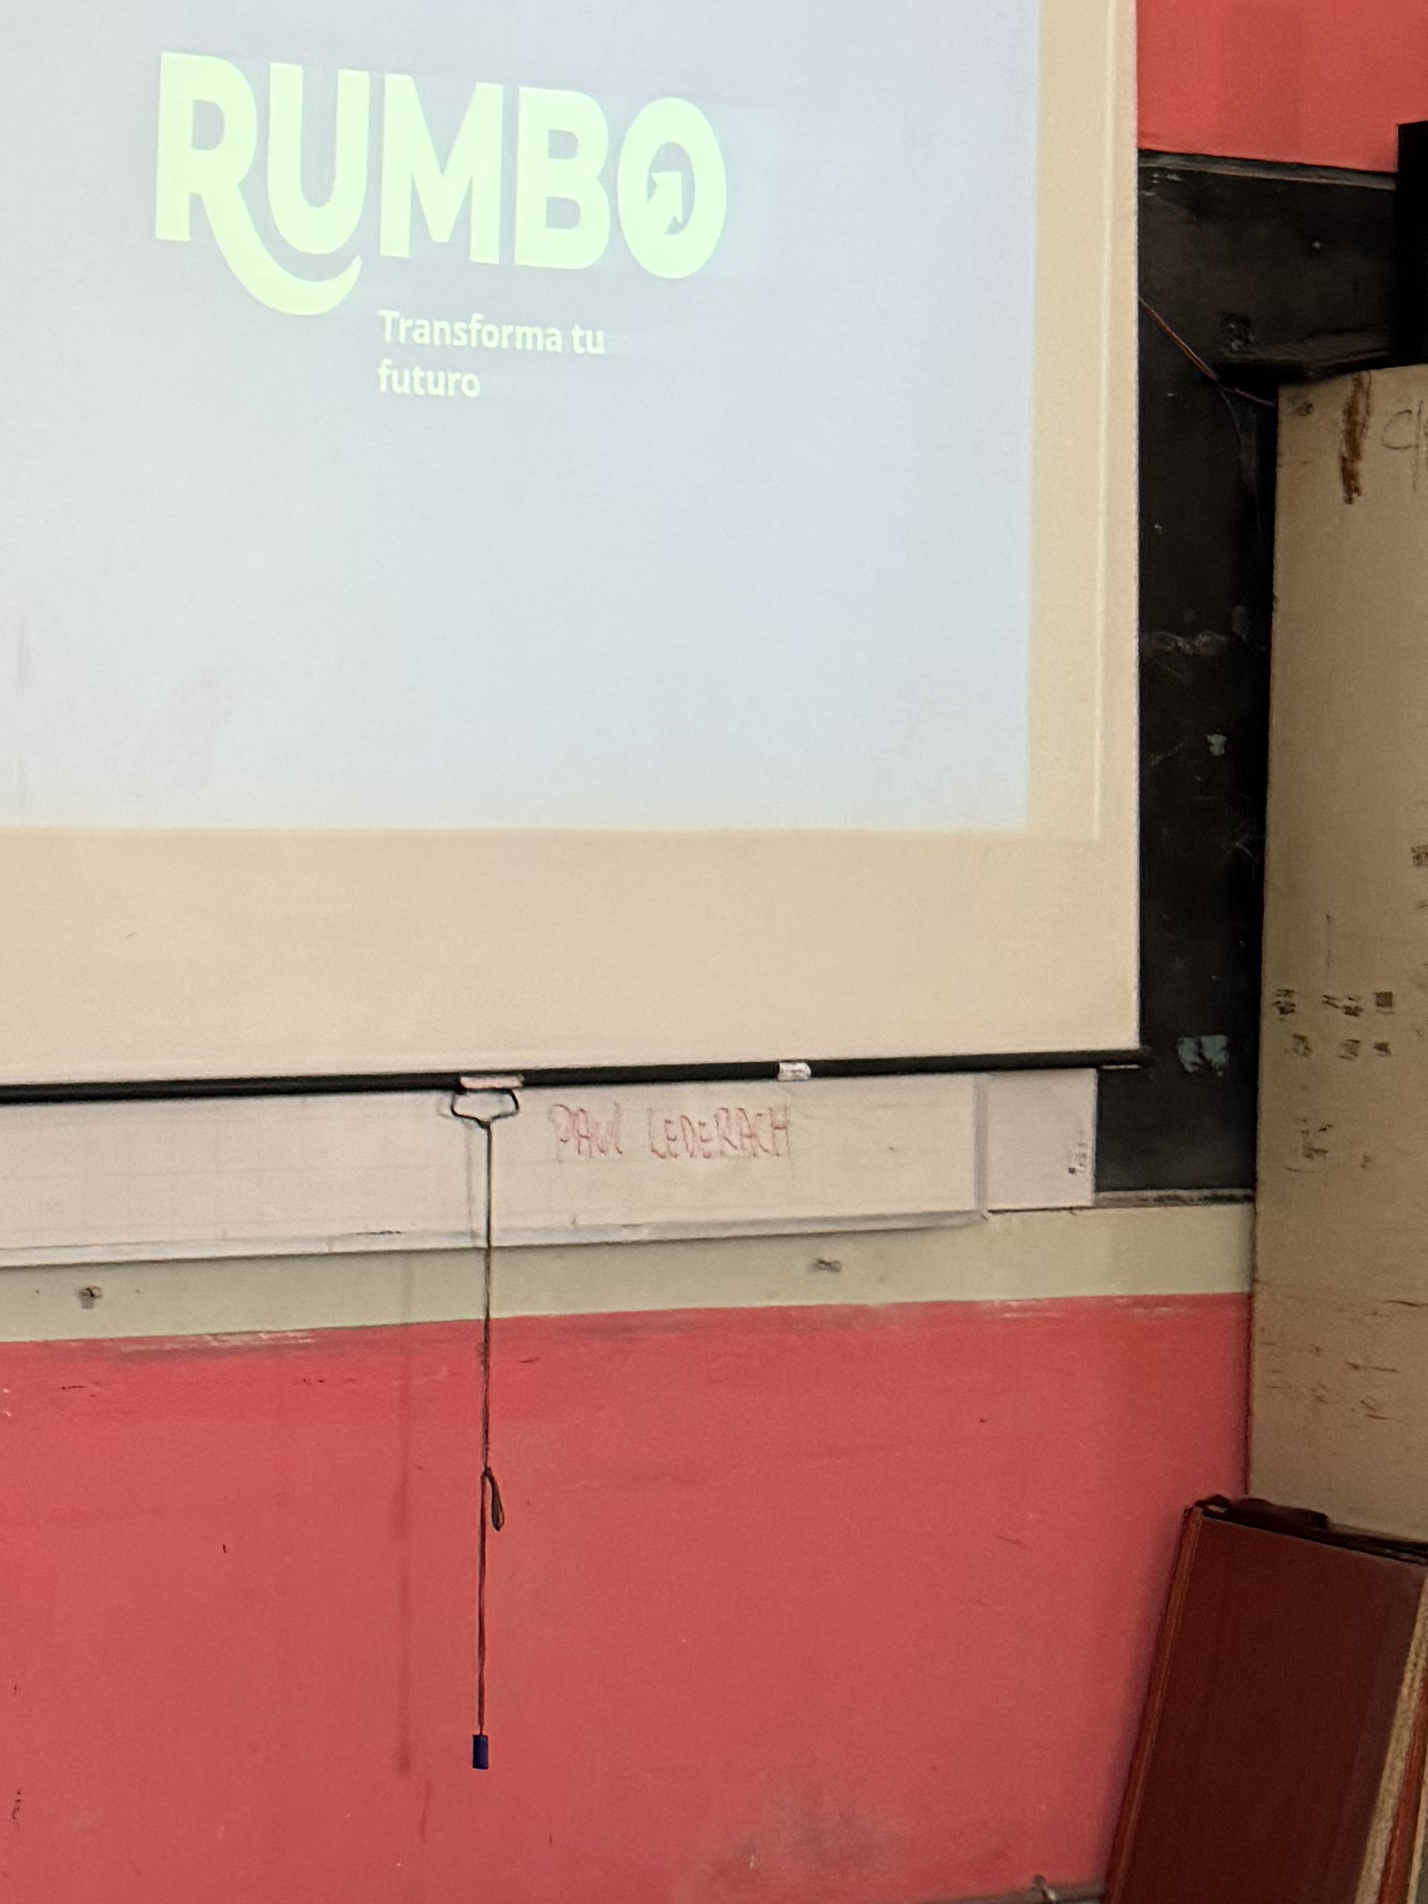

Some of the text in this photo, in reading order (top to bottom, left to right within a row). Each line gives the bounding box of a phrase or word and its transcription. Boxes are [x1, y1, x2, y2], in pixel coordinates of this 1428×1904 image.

[154, 51, 727, 316] RUMBO
[377, 309, 606, 356] Transforma tu
[377, 359, 481, 398] futuro
